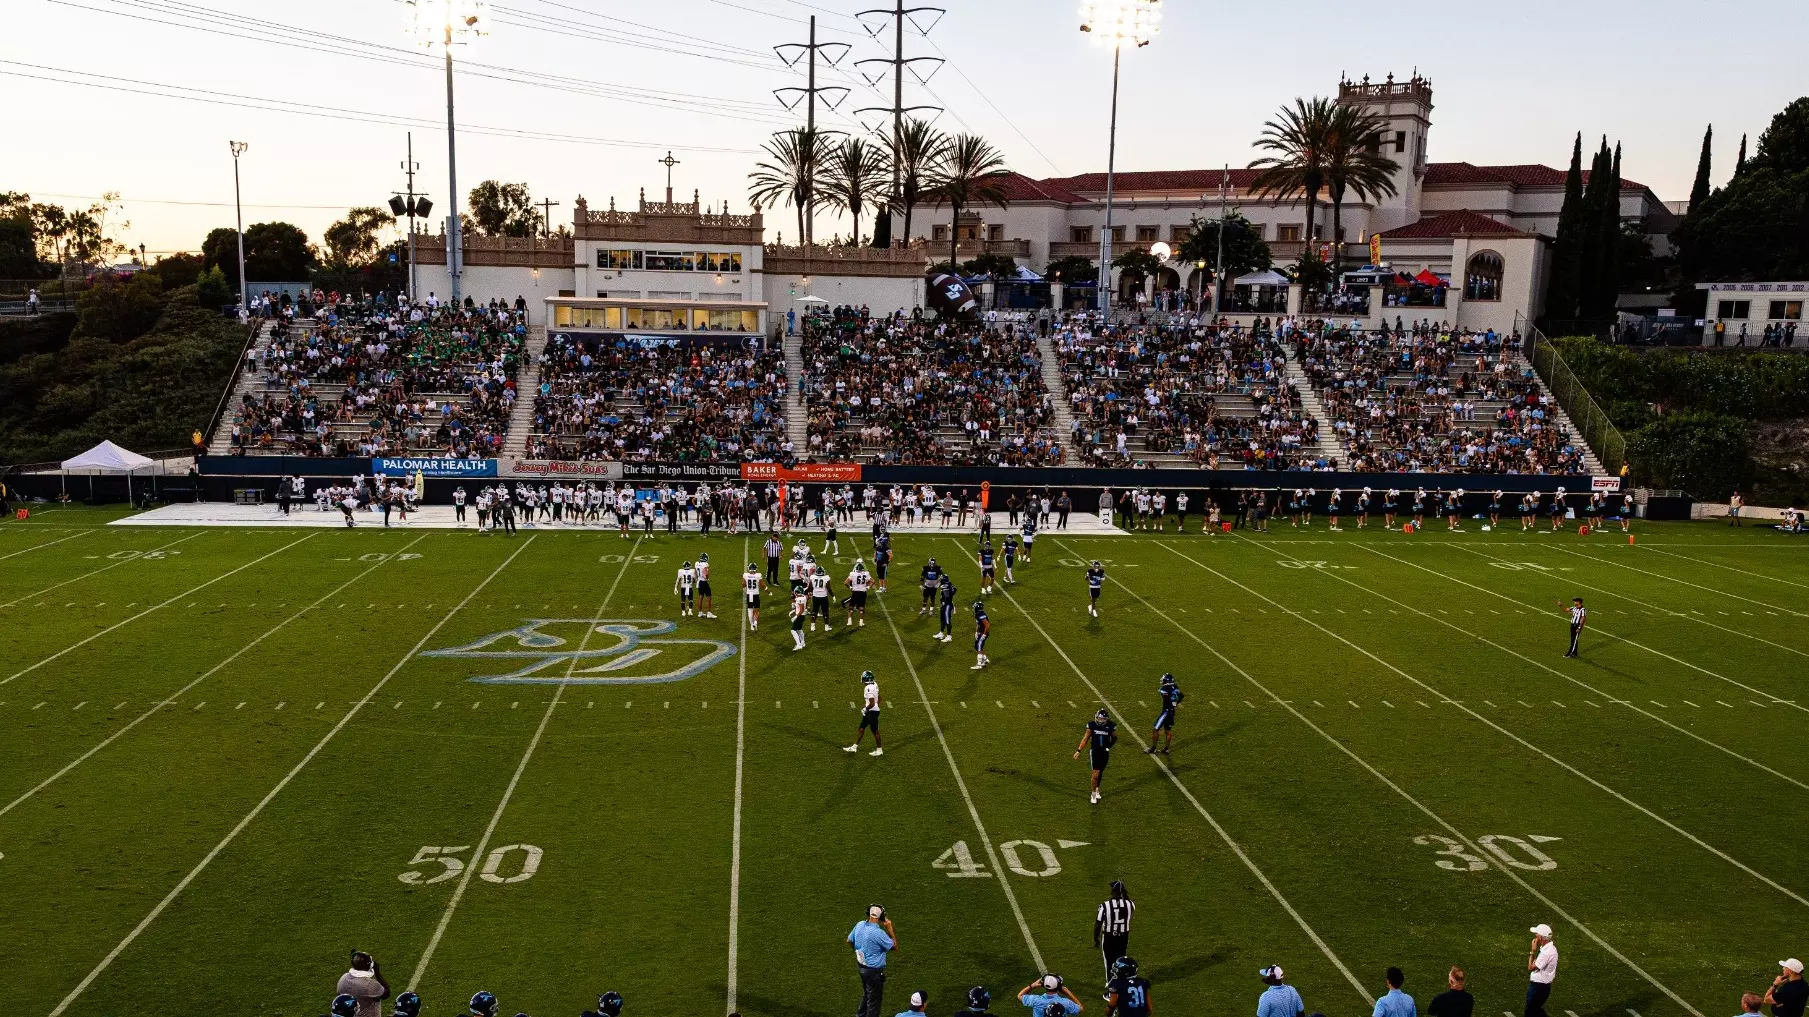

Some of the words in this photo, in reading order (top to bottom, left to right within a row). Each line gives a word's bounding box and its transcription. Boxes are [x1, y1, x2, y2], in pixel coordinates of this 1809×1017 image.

[383, 459, 438, 470] PALOMAR
[441, 460, 486, 470] HEALTH
[513, 461, 548, 476] Jersey
[580, 463, 608, 475] Subs
[747, 466, 776, 474] BAKER
[623, 464, 640, 475] The
[658, 464, 681, 477] Diego
[682, 465, 740, 476] Union-Tribune
[1593, 479, 1620, 488] ESPN
[598, 554, 659, 563] 50
[683, 575, 692, 584] 19
[747, 579, 757, 590] 85
[813, 578, 824, 588] 70
[856, 575, 867, 585] 65
[931, 840, 1061, 877] 40
[1411, 834, 1556, 872] 30
[397, 844, 543, 884] 50
[1113, 908, 1126, 924] L
[1127, 985, 1145, 1008] 31
